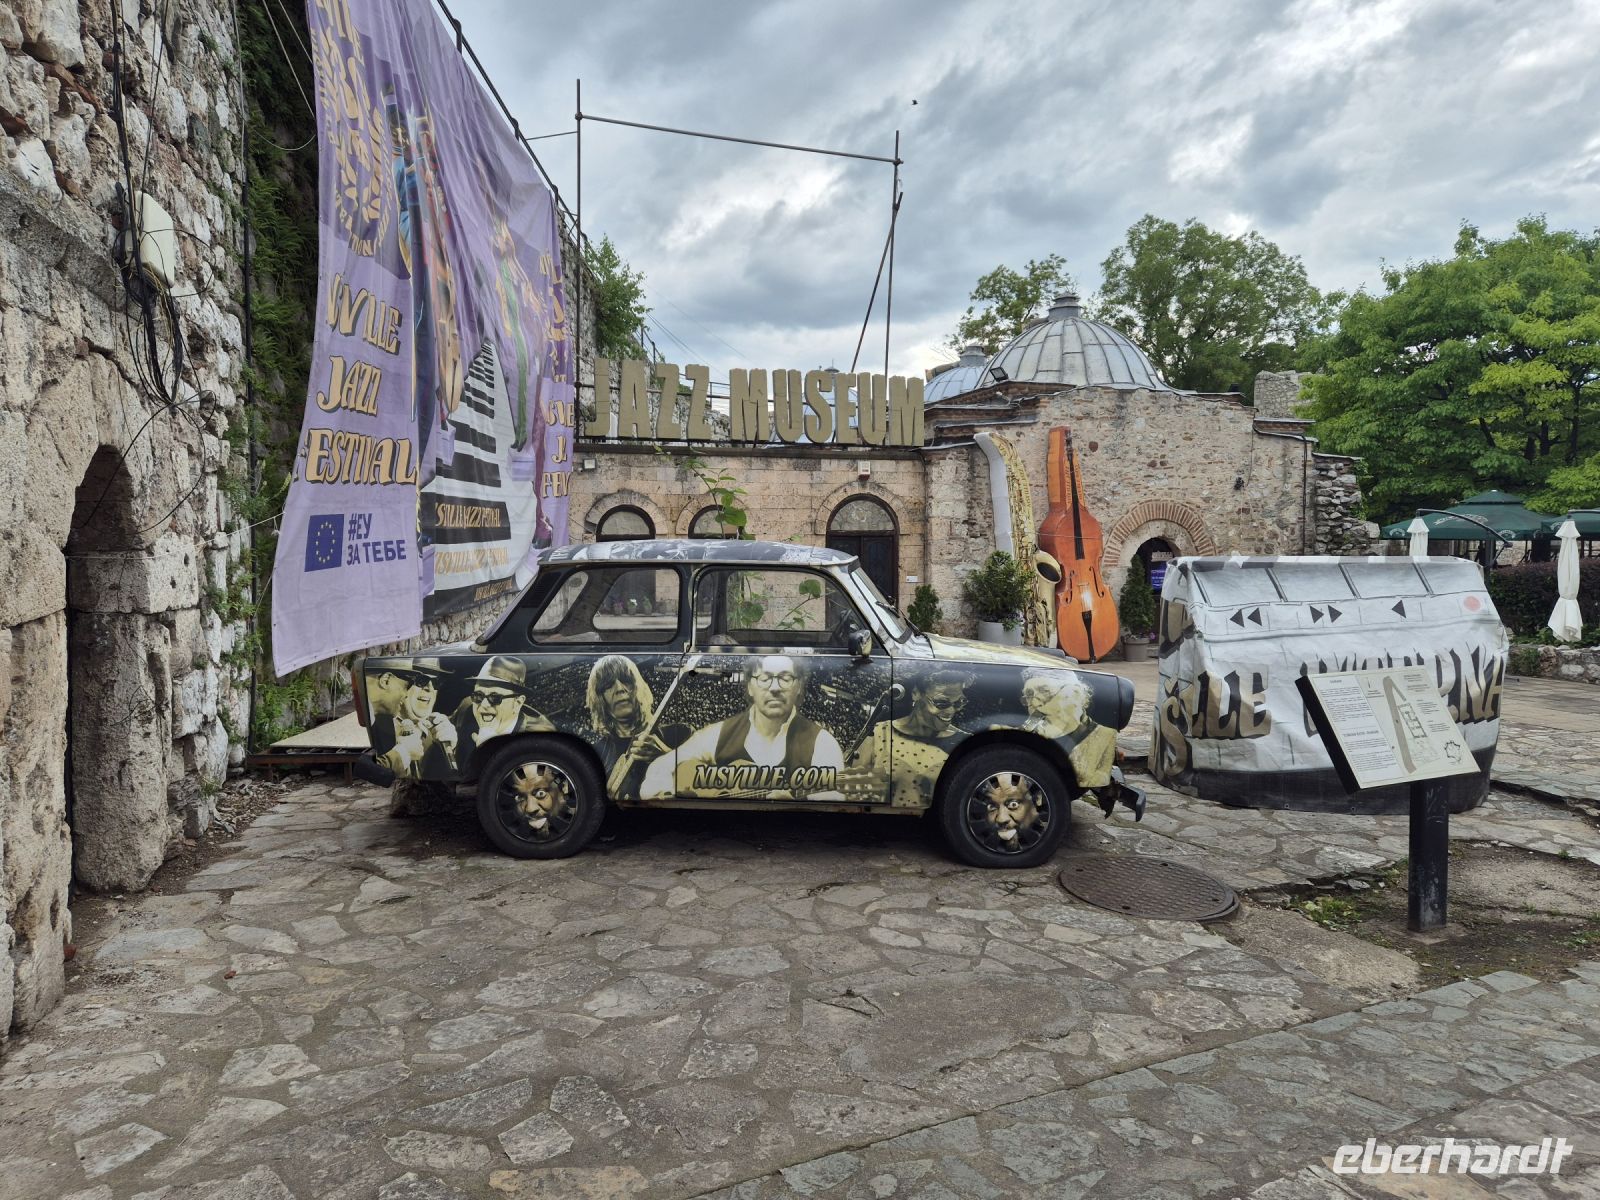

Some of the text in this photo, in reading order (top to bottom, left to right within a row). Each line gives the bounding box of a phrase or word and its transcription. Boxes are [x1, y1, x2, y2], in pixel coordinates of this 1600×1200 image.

[316, 355, 382, 417] JAZZ
[584, 358, 924, 447] JAZZ MUSEUM
[362, 539, 407, 563] ТЕБЕ
[693, 765, 837, 790] NISVILLE.COM
